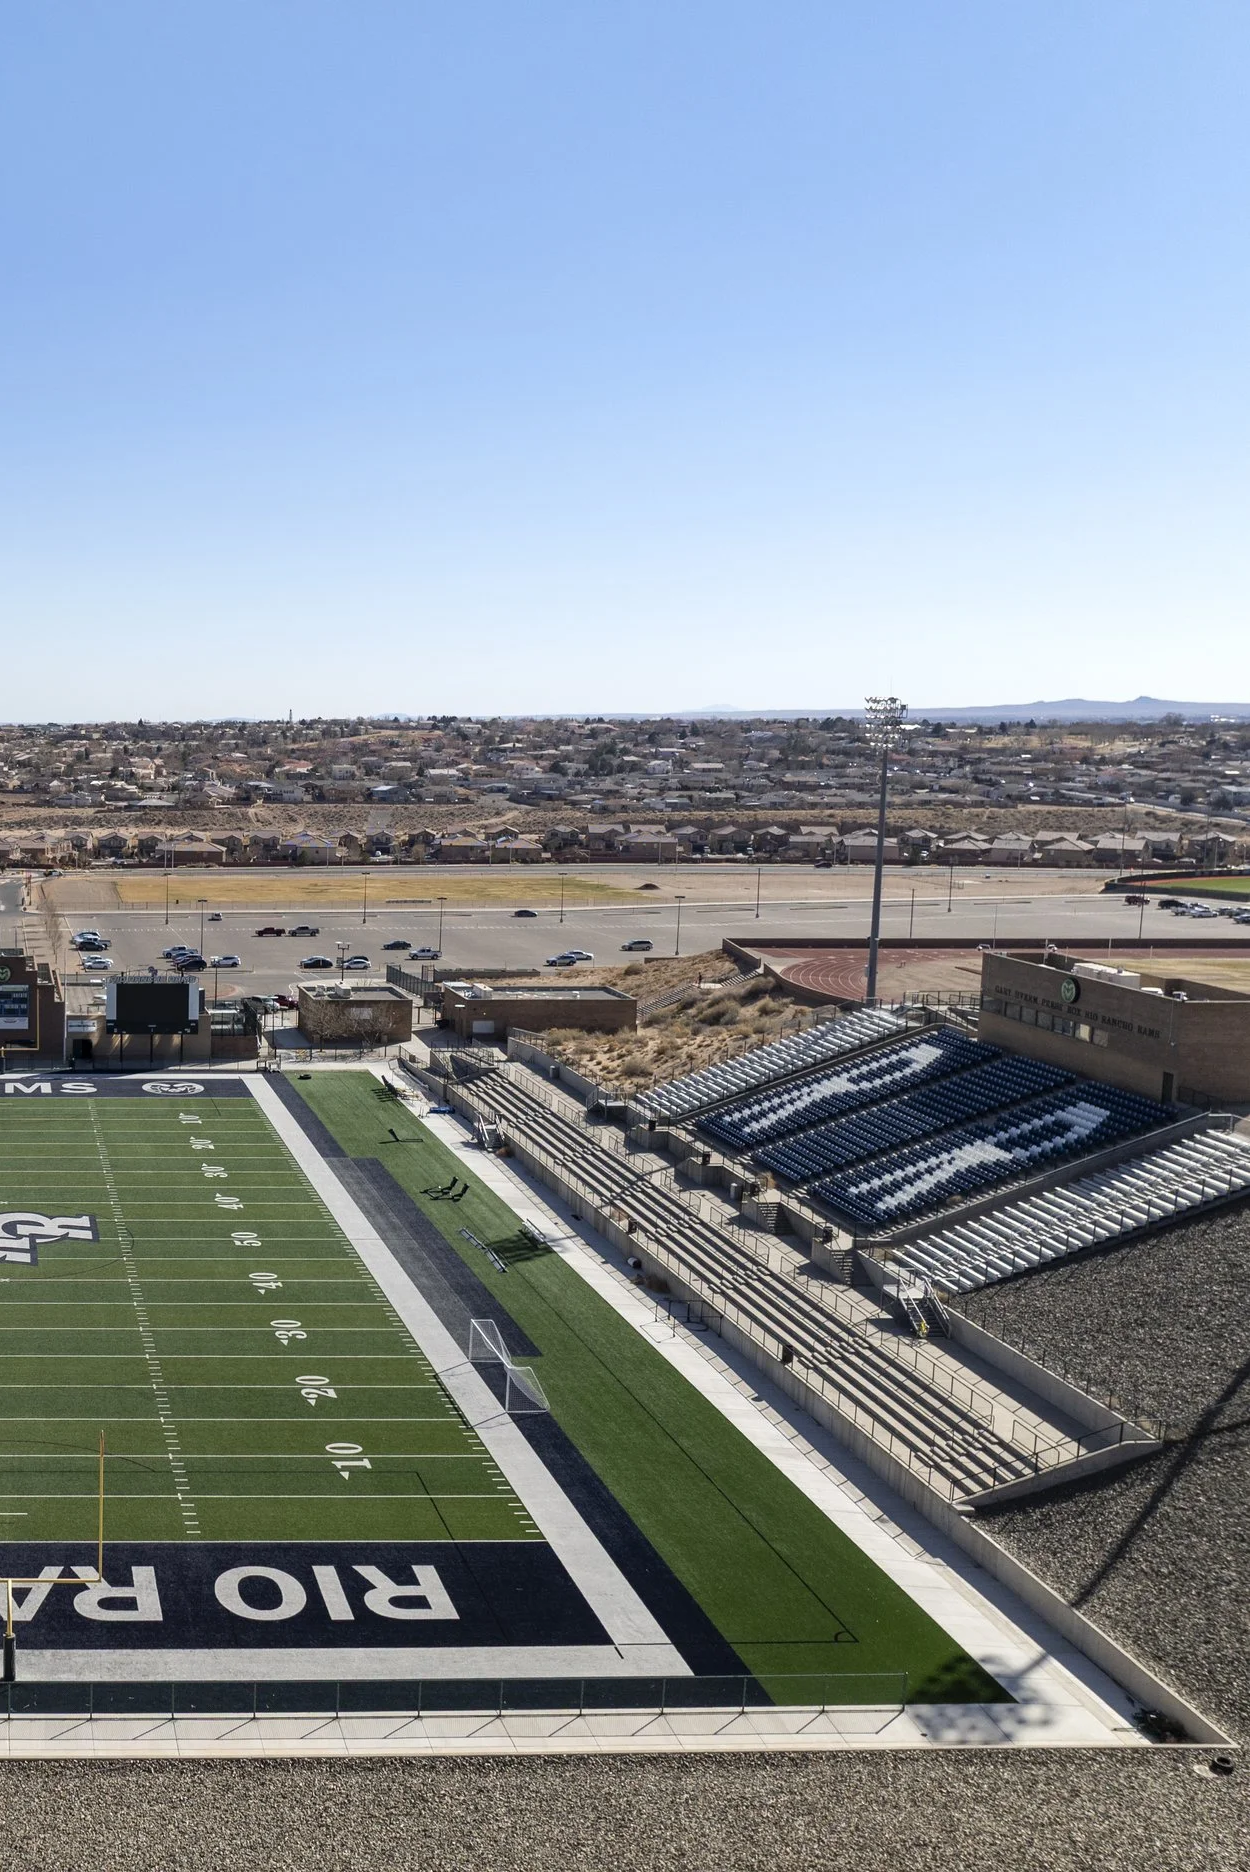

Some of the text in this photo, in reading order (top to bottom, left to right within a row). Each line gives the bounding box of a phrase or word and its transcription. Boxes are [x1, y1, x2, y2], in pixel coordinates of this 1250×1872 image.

[1067, 1006, 1081, 1016] BOX
[1085, 1009, 1098, 1021] RIO
[1101, 1015, 1134, 1032] RANCHO
[179, 1114, 202, 1125] 10
[189, 1138, 214, 1150] 20
[201, 1165, 228, 1178] 30
[214, 1196, 243, 1210] 40
[230, 1232, 261, 1247] 50
[248, 1272, 282, 1290] 40
[270, 1319, 307, 1339] 30
[295, 1375, 337, 1399] 20
[325, 1442, 372, 1470] 10
[214, 1565, 460, 1621] RIO
